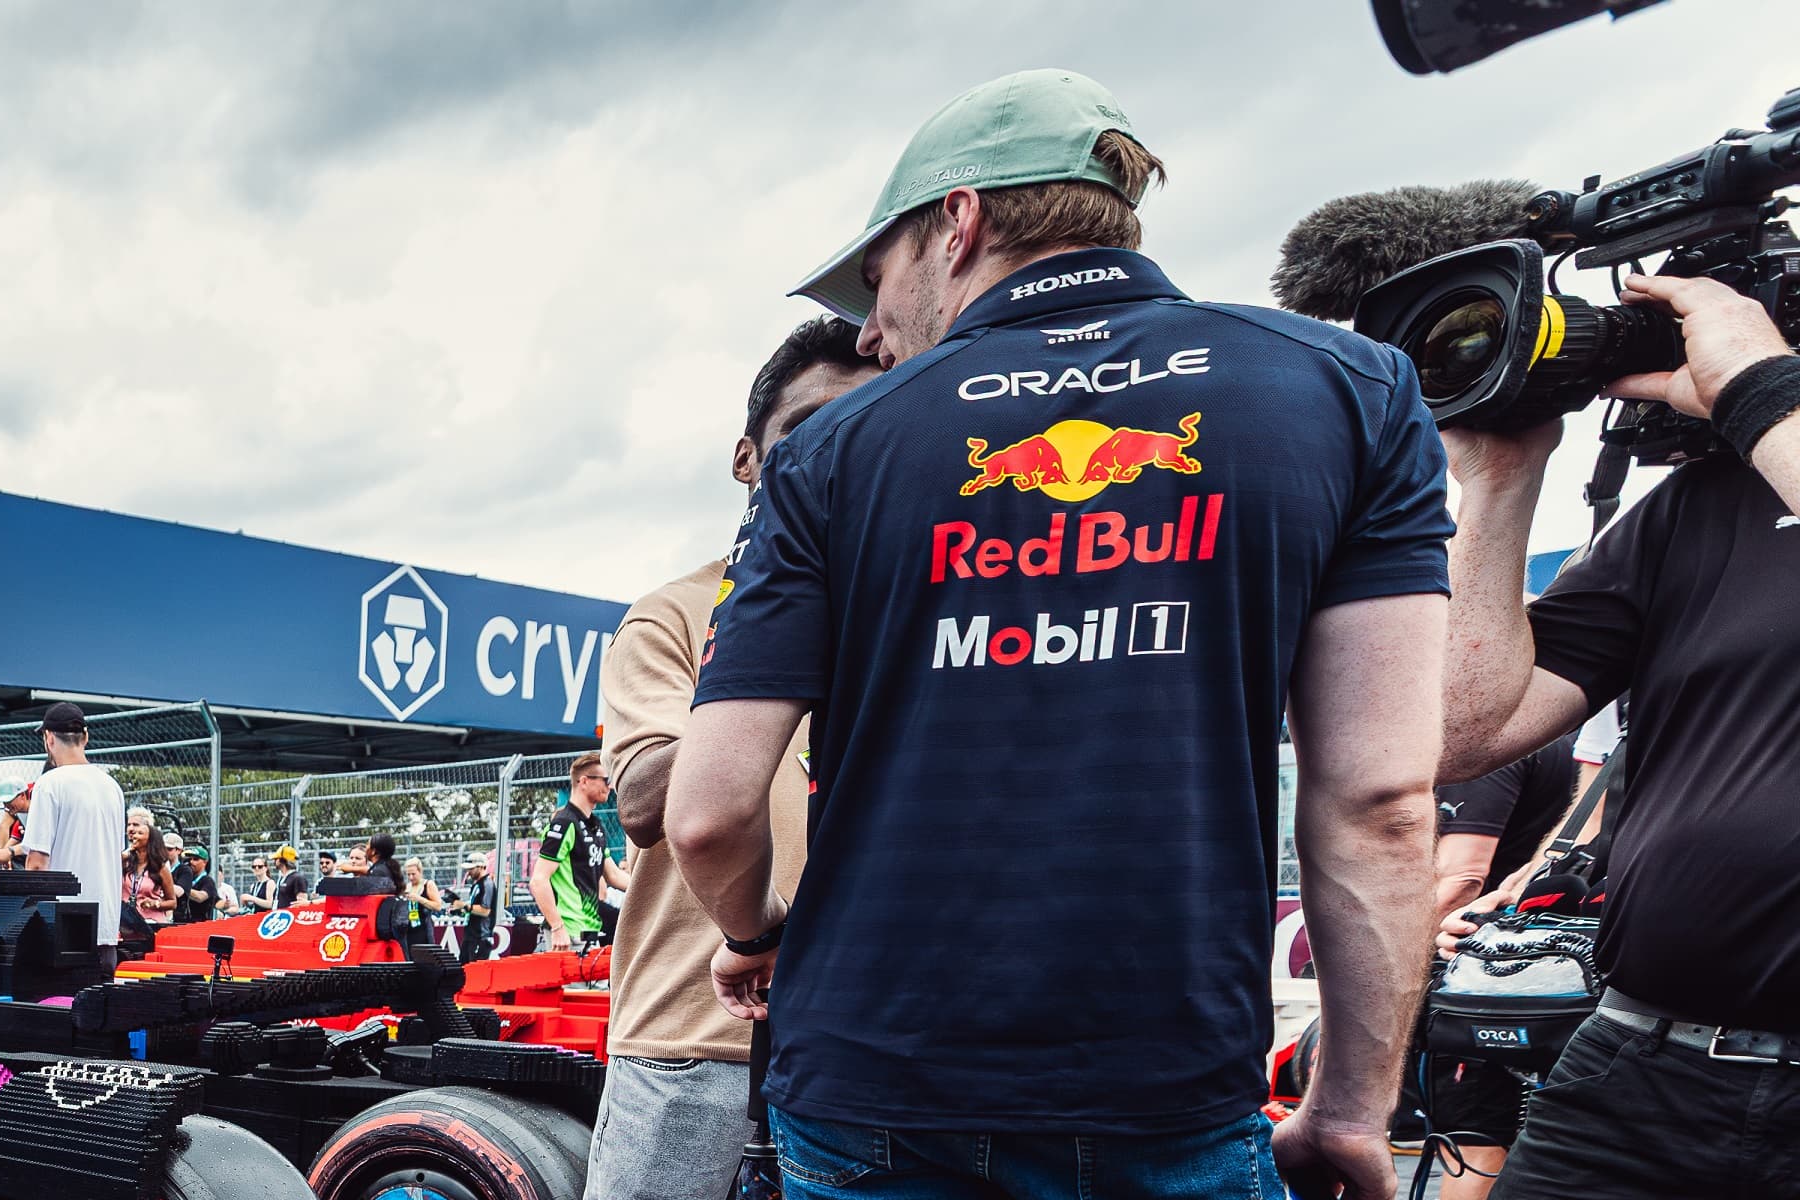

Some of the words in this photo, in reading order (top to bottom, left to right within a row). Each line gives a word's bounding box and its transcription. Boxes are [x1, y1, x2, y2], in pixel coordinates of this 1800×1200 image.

[1010, 266, 1130, 301] HONDA
[1047, 330, 1111, 345] CASTORE
[958, 347, 1211, 402] ORACLE
[930, 511, 1068, 584] Red
[1075, 492, 1225, 575] Bull
[930, 606, 1119, 670] Mobil
[1477, 1029, 1519, 1042] ORCA
